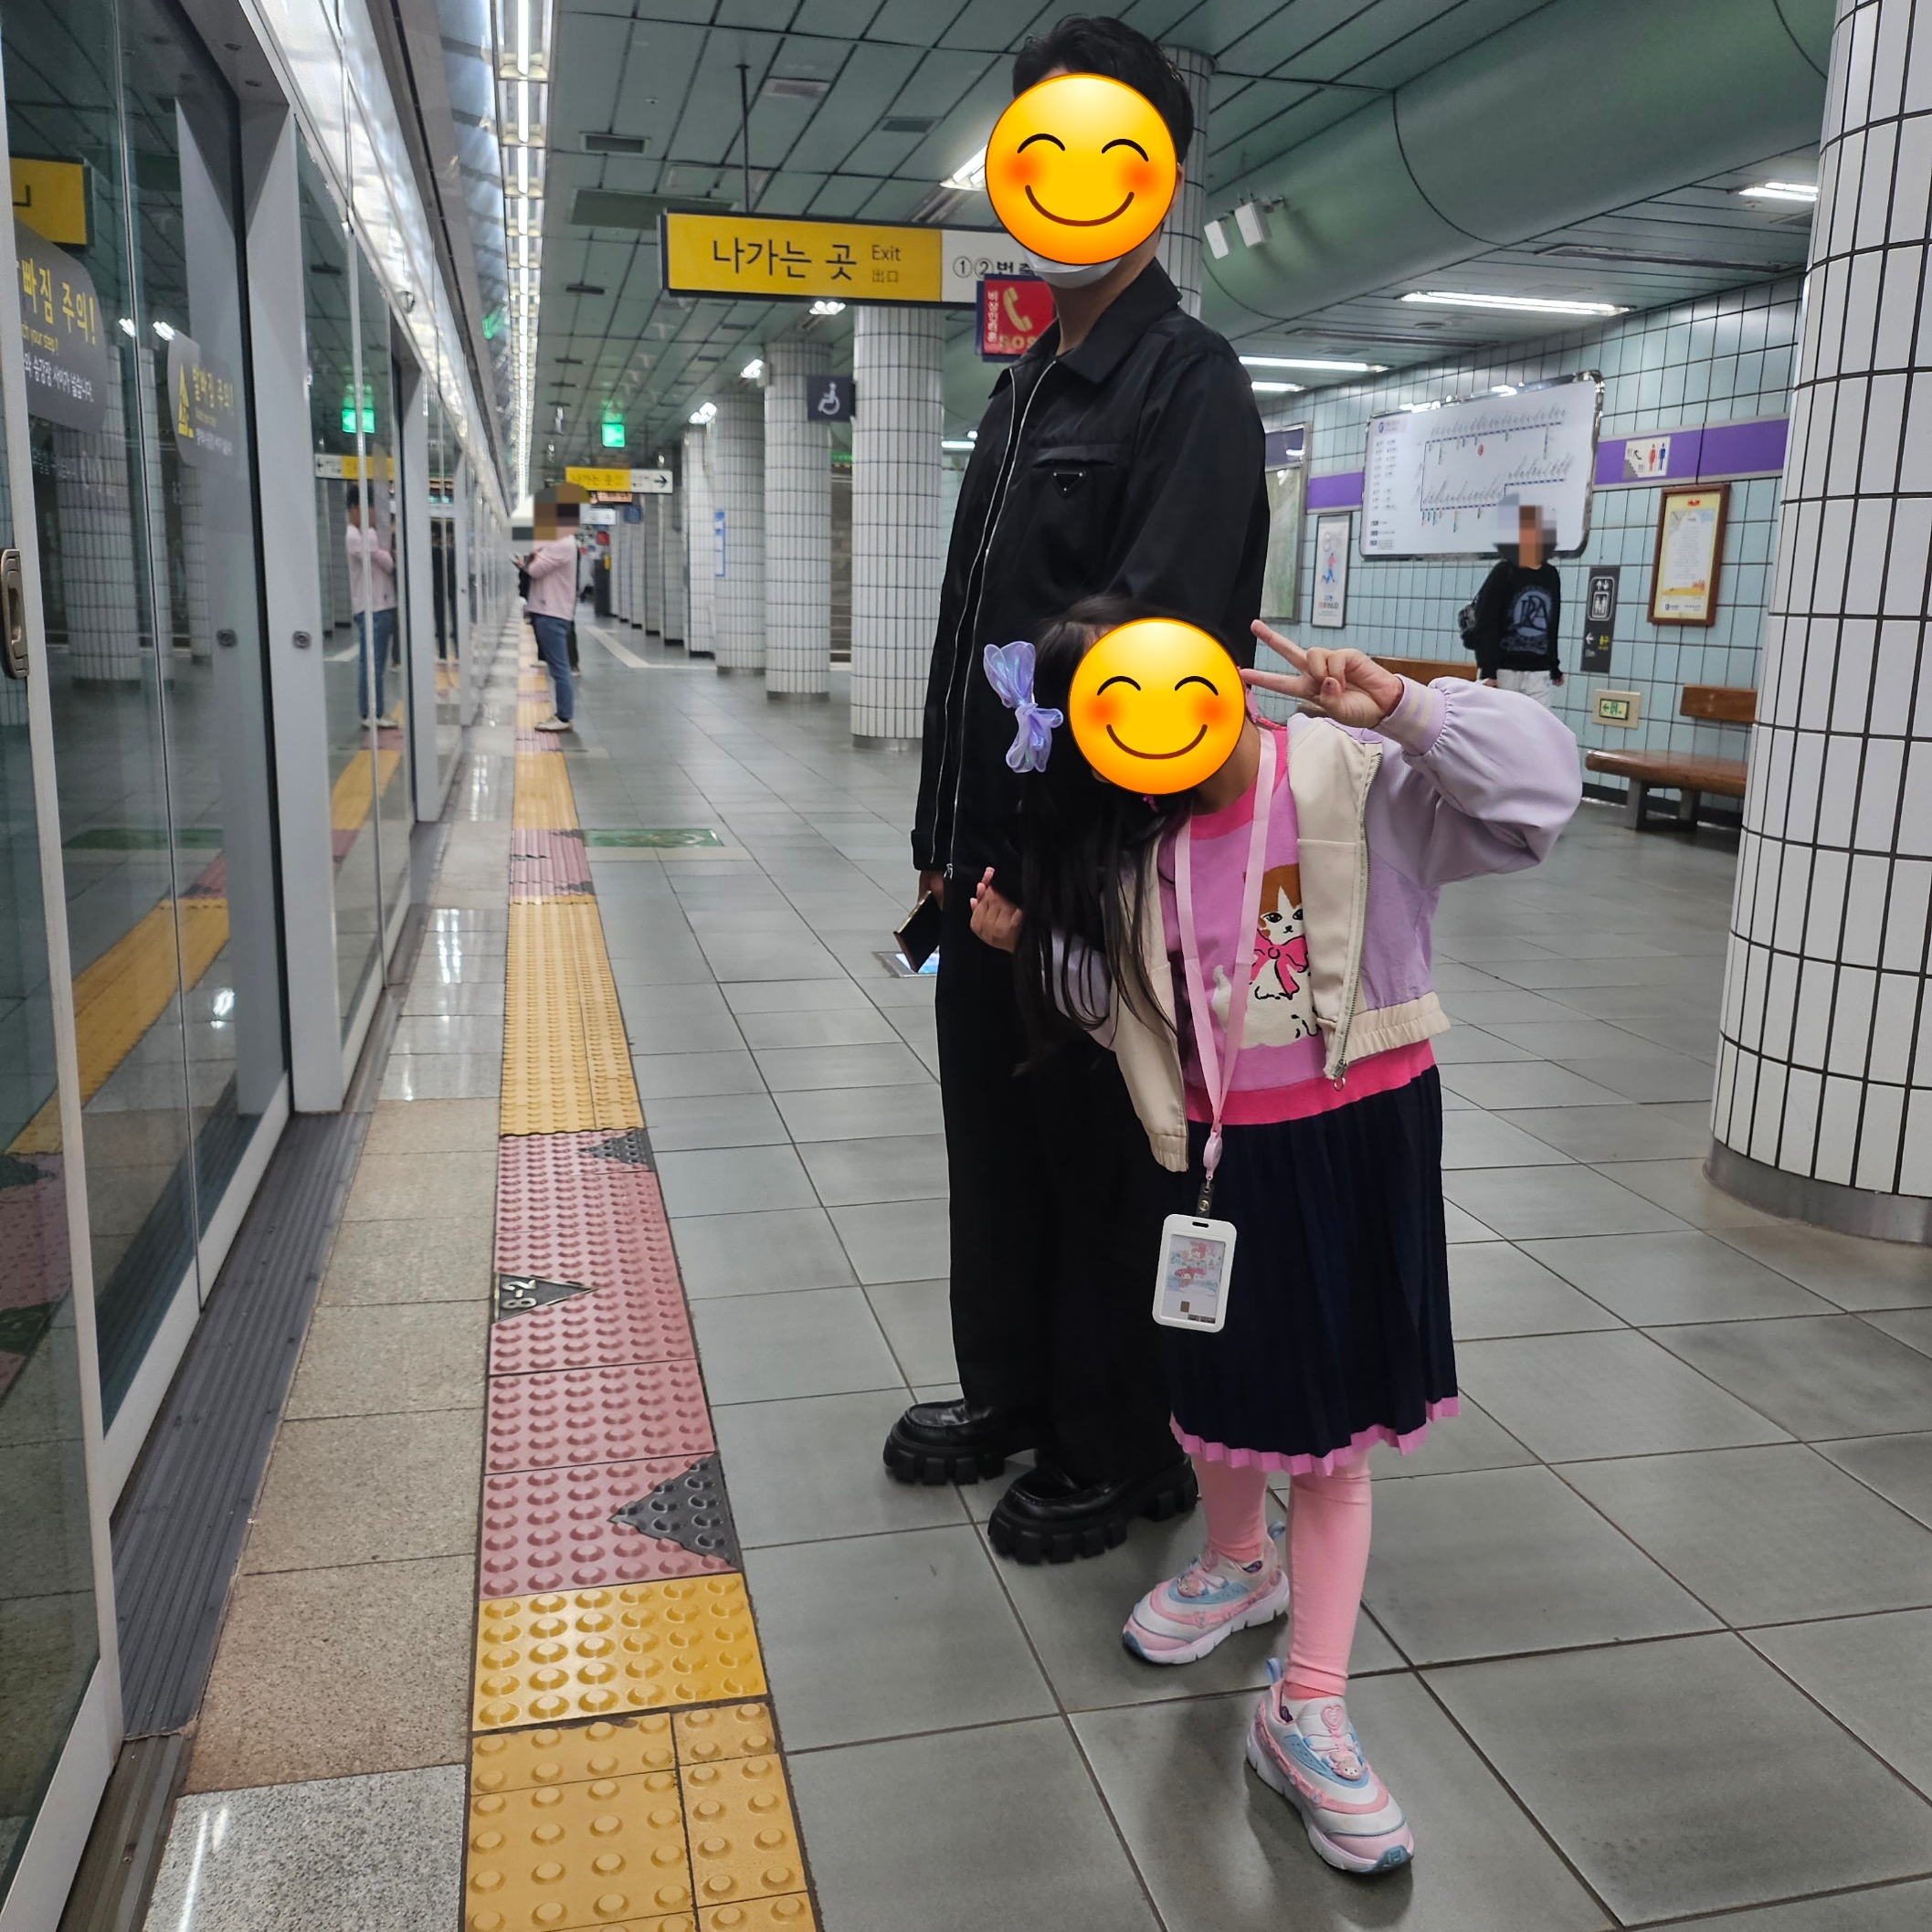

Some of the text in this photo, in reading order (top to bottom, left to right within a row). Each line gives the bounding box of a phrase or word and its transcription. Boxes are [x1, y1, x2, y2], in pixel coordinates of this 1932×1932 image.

[713, 237, 858, 280] 나가는 곳
[871, 244, 902, 262] Exit
[871, 269, 900, 284] 出口
[16, 258, 96, 345] 빠짐 주의!
[501, 1279, 538, 1310] 8-2
